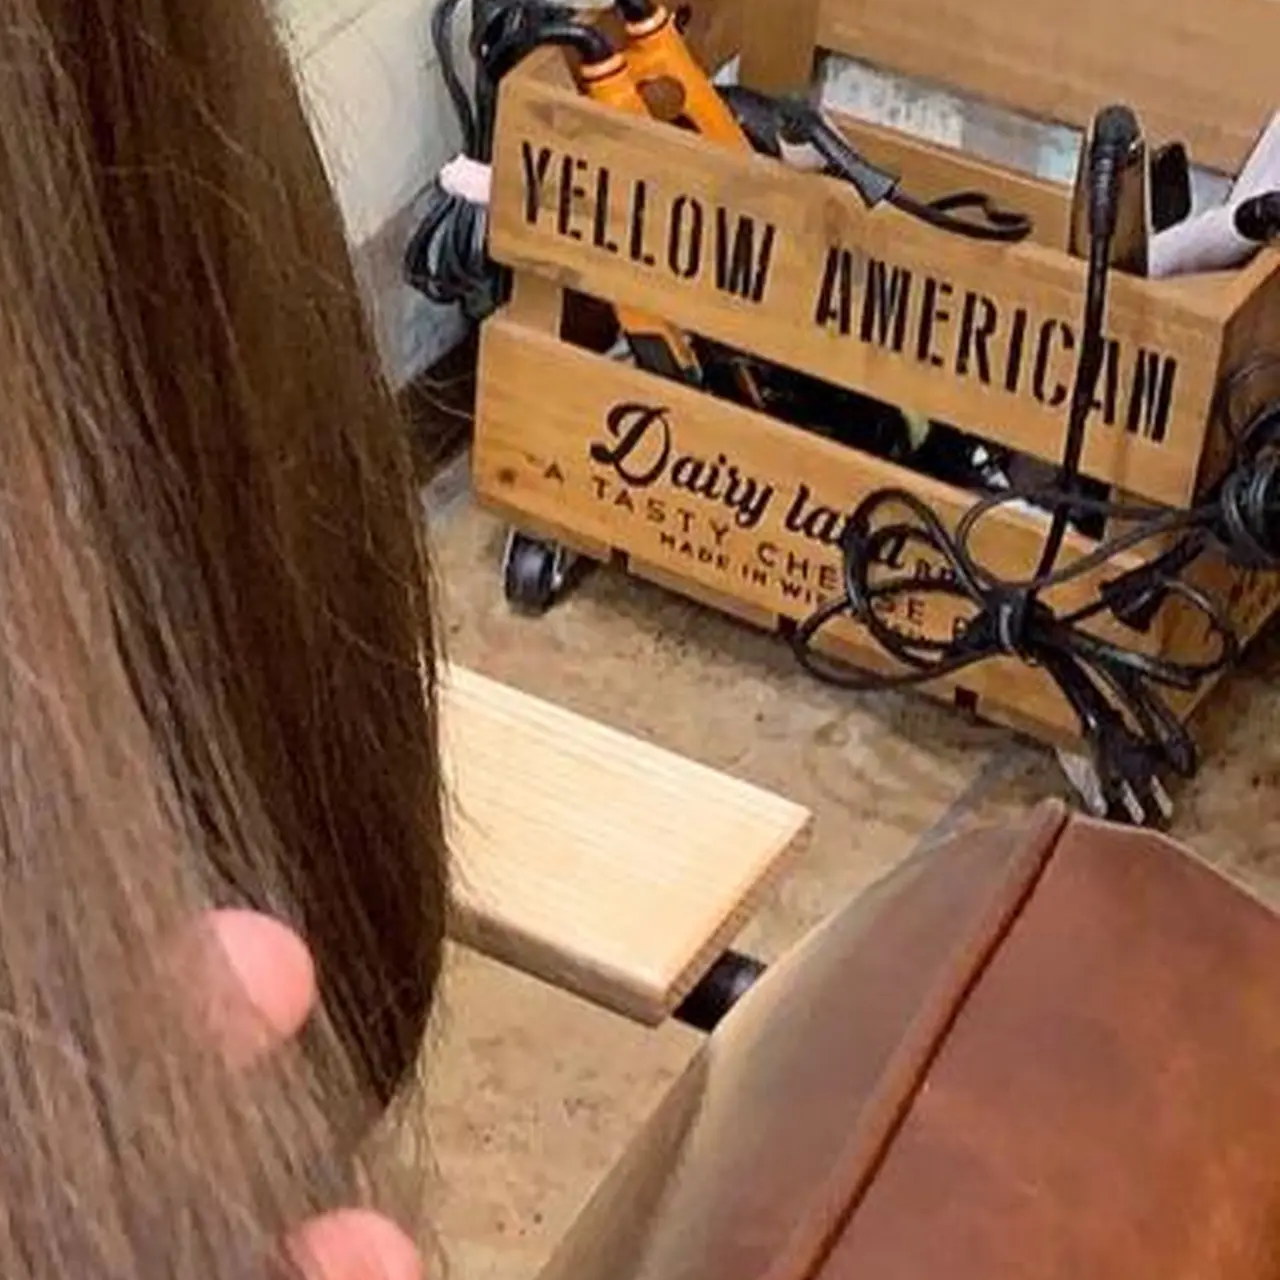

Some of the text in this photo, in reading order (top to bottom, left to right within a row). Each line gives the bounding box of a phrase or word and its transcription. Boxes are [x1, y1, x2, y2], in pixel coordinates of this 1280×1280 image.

[520, 140, 1178, 443] YELLOW AMERICAN
[590, 402, 773, 528] Dairy
[592, 476, 730, 546] TASTY
[659, 531, 771, 590] MADE IN
